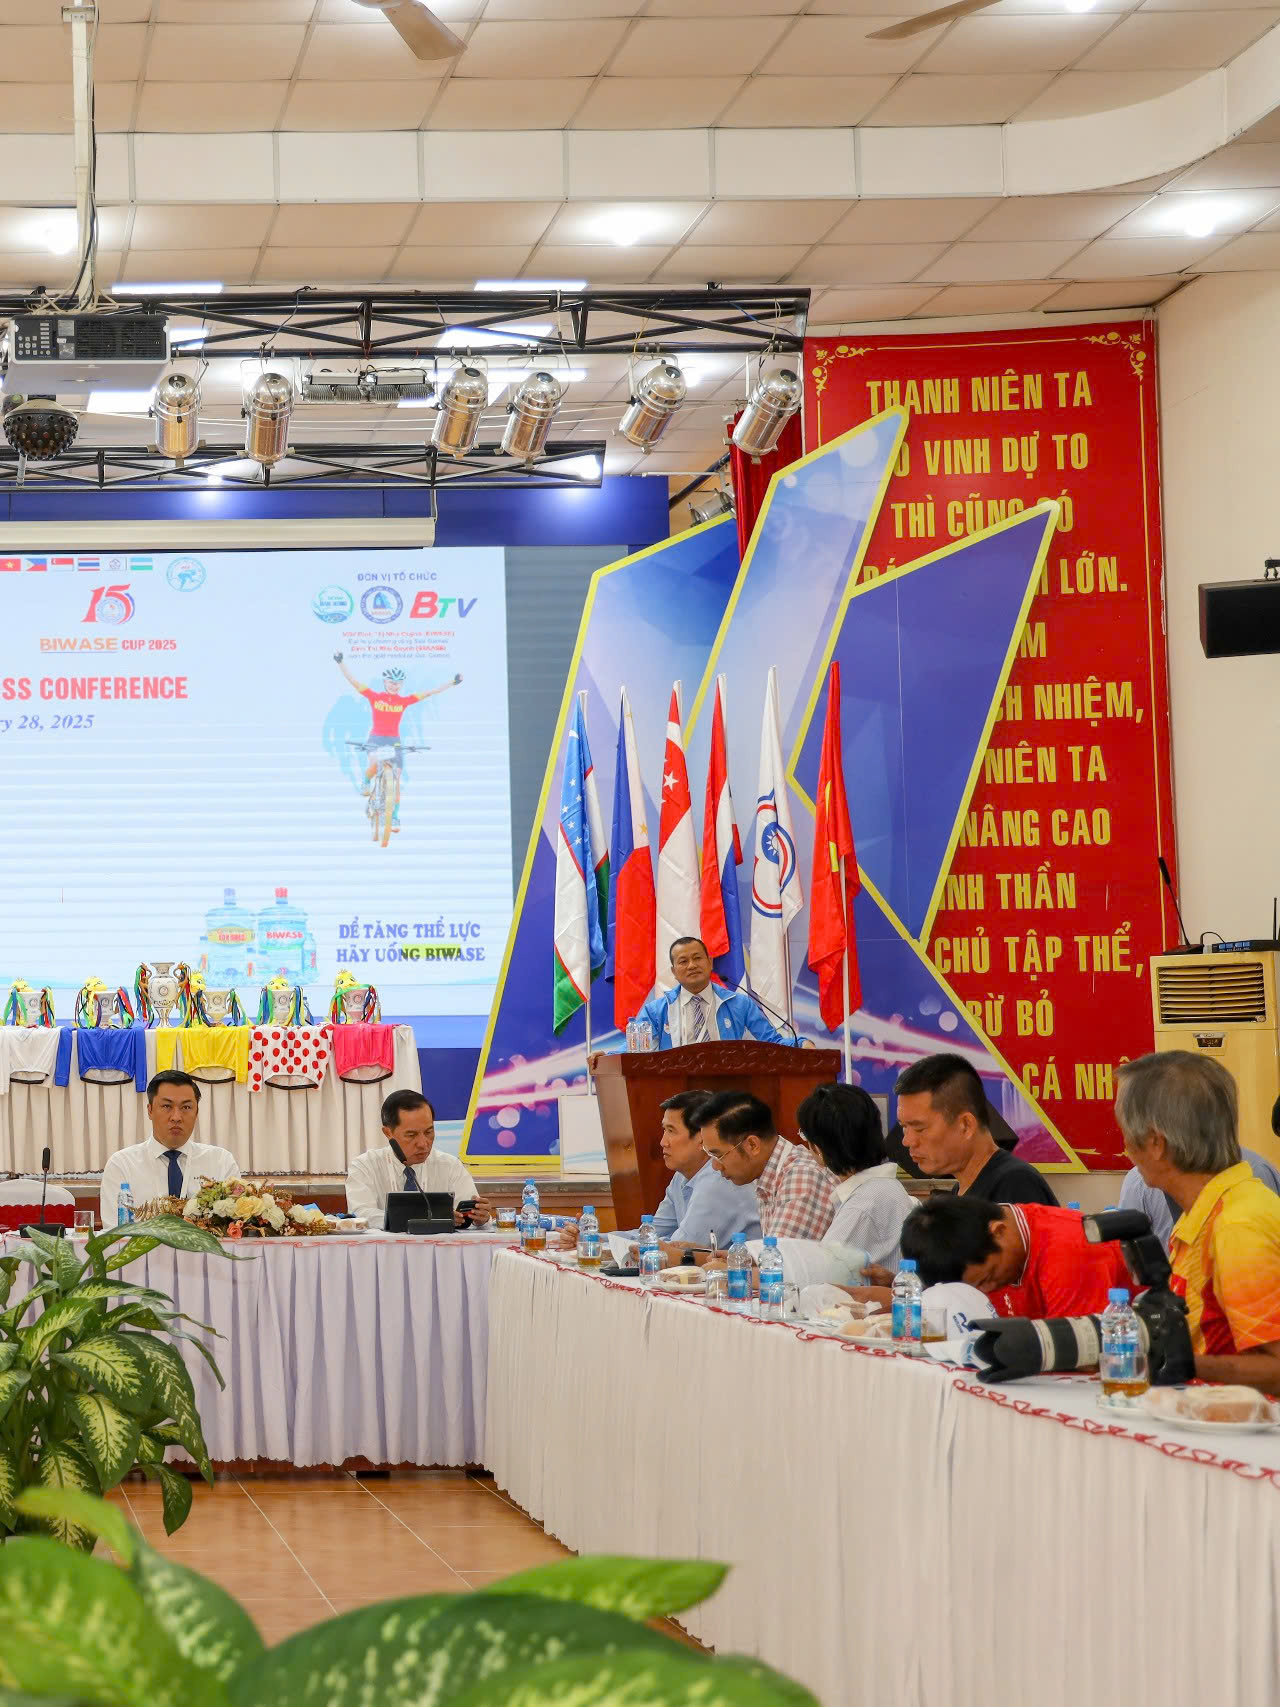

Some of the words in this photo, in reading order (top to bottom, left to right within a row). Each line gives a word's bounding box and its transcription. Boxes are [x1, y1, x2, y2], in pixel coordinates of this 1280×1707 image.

[866, 378, 960, 416] THANH
[971, 369, 1043, 411] NIÊN
[1054, 371, 1093, 408] TA
[924, 438, 990, 476] VINH
[1003, 430, 1040, 479] DỰ
[1052, 433, 1088, 470] TO
[891, 494, 935, 539] THÌ
[1060, 550, 1128, 595] LỚN.
[409, 591, 478, 618] BTV
[40, 637, 119, 651] BIWASE
[122, 639, 146, 651] CUP
[148, 639, 177, 651] 2025
[40, 676, 188, 701] CONFERENCE
[1034, 675, 1144, 727] NHIỆM,
[19, 714, 44, 732] 28,
[51, 714, 95, 730] 2025
[985, 741, 1057, 785] NIÊN
[1068, 745, 1107, 783] TA
[959, 804, 1040, 847] NÂNG
[1051, 808, 1110, 846] CAO
[996, 861, 1076, 910] THẦN
[363, 920, 409, 939] TĂNG
[413, 916, 445, 938] THỂ
[450, 920, 481, 942] LỰC
[336, 944, 371, 963] HÃY
[375, 941, 421, 963] UỐNG
[425, 947, 485, 962] BIWASE
[934, 927, 990, 974] CHỦ
[1004, 929, 1062, 981] TẬP
[1074, 922, 1143, 977] THỂ,
[1017, 989, 1054, 1036] BỎ
[1022, 1056, 1062, 1100] CÁ
